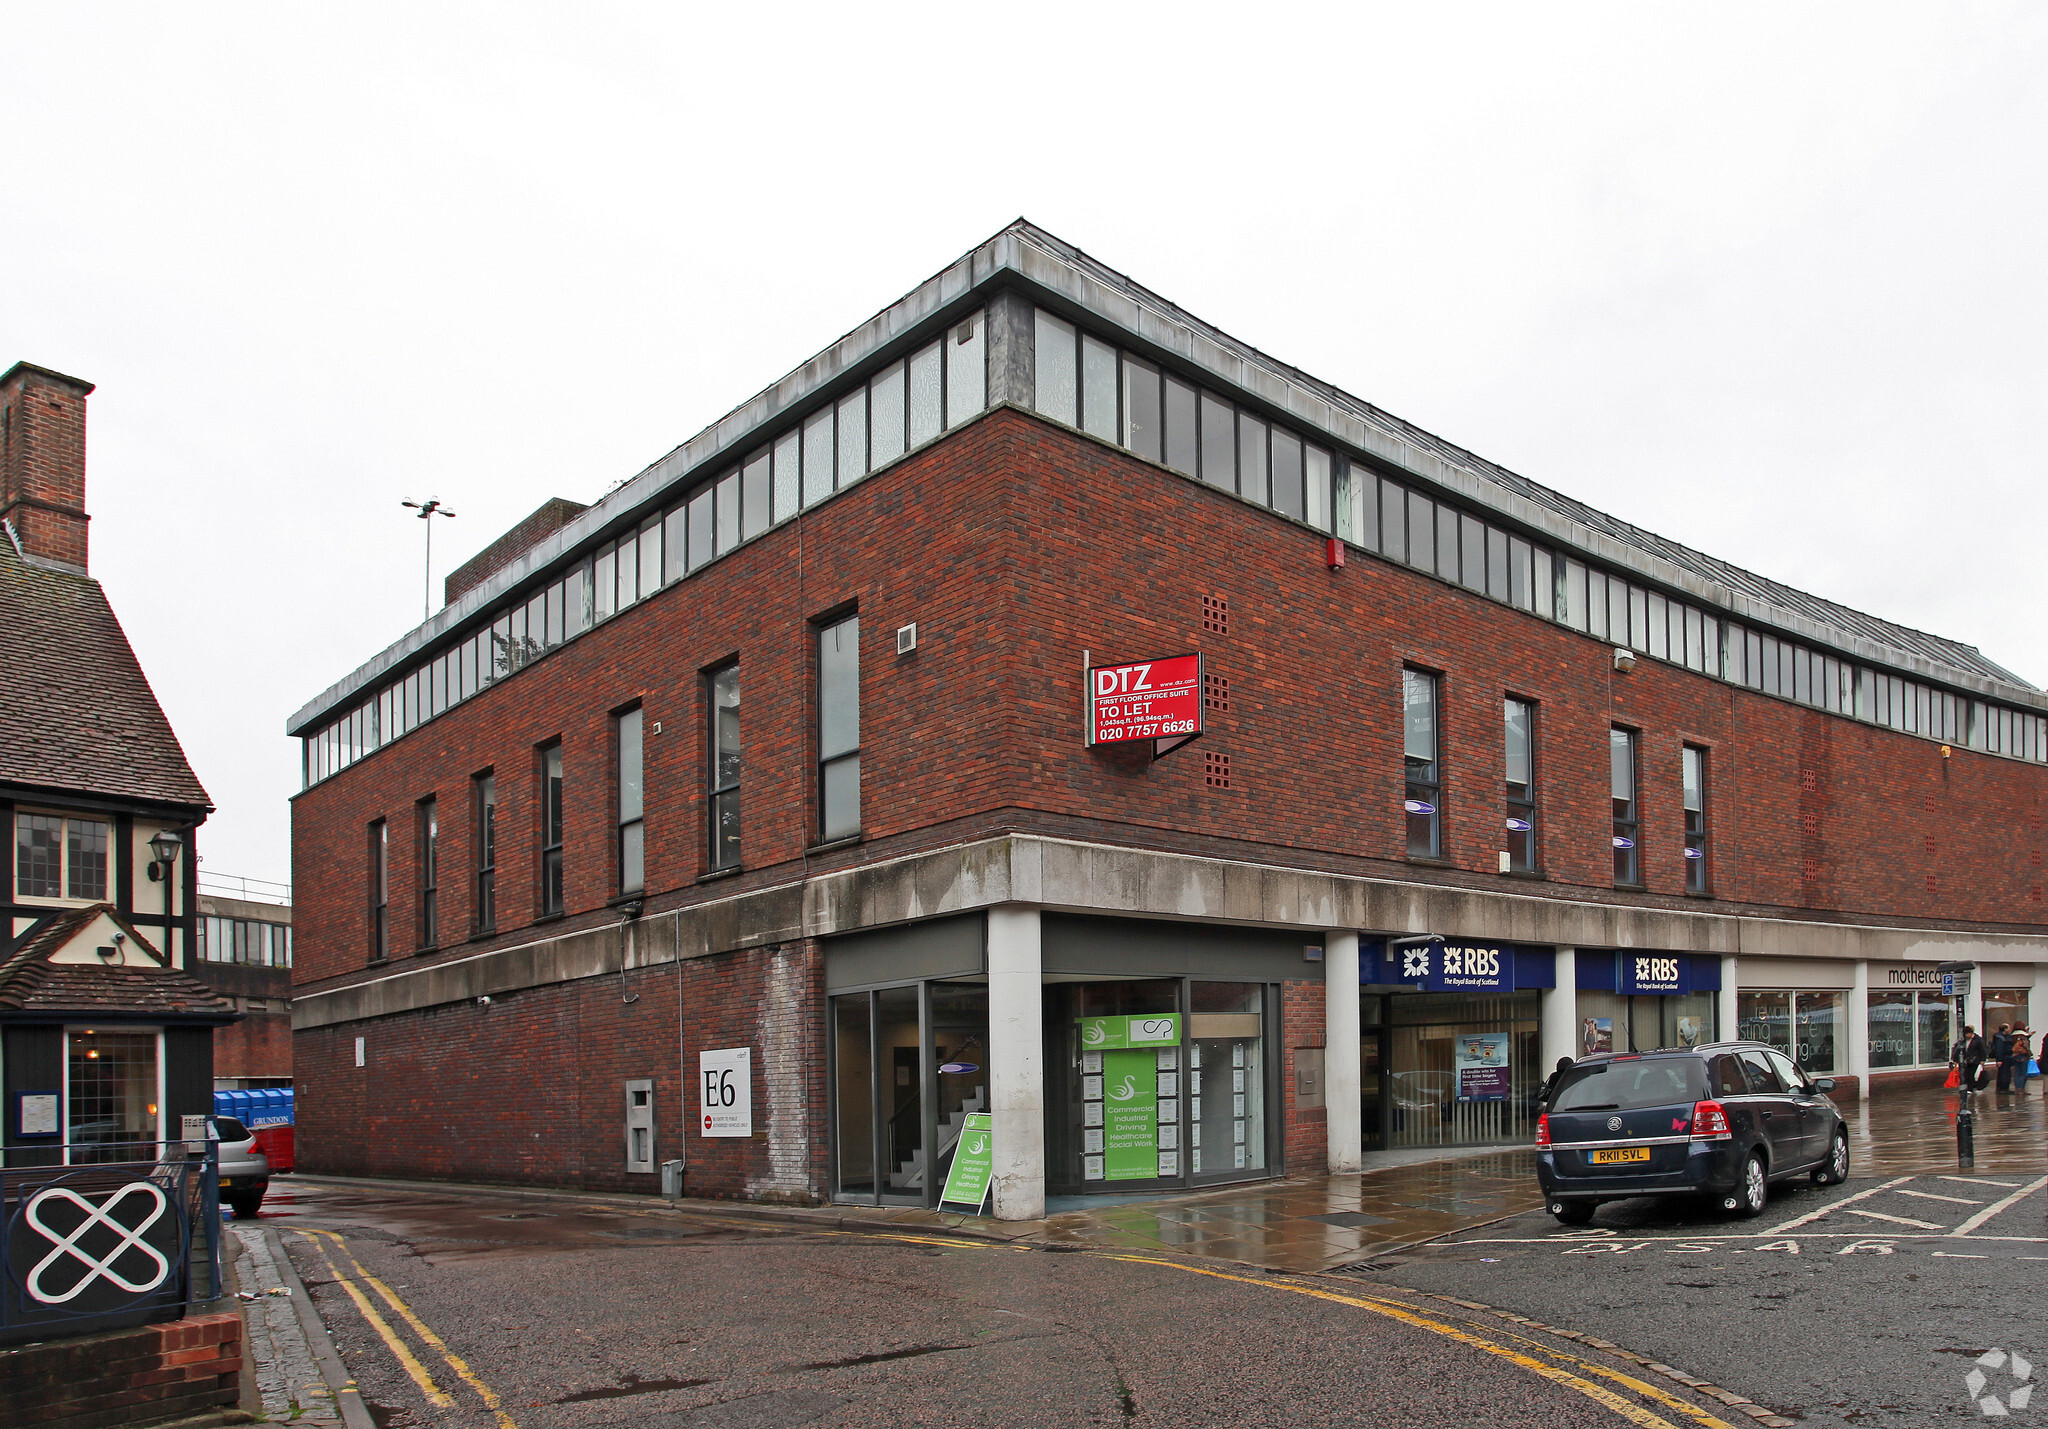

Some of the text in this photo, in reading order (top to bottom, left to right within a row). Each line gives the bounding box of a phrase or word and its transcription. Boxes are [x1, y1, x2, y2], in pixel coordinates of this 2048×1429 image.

[1098, 664, 1152, 696] DTZ
[1160, 678, 1196, 687] www.dtz.com
[1120, 695, 1142, 703] FLOOR
[1144, 692, 1168, 700] OFFICE
[1099, 702, 1152, 719] TO LET
[1100, 719, 1194, 740] 020 7757 6626
[1464, 948, 1500, 976] RBS
[1652, 958, 1679, 982] RBS
[1889, 964, 1944, 984] motherca
[1453, 978, 1465, 986] Royal
[1476, 978, 1482, 987] of
[1945, 976, 1952, 984] P
[703, 1069, 736, 1107] E6
[1107, 1105, 1155, 1114] Commercial
[253, 1116, 289, 1124] GRUNDON
[1600, 1150, 1644, 1161] RK11 SVL
